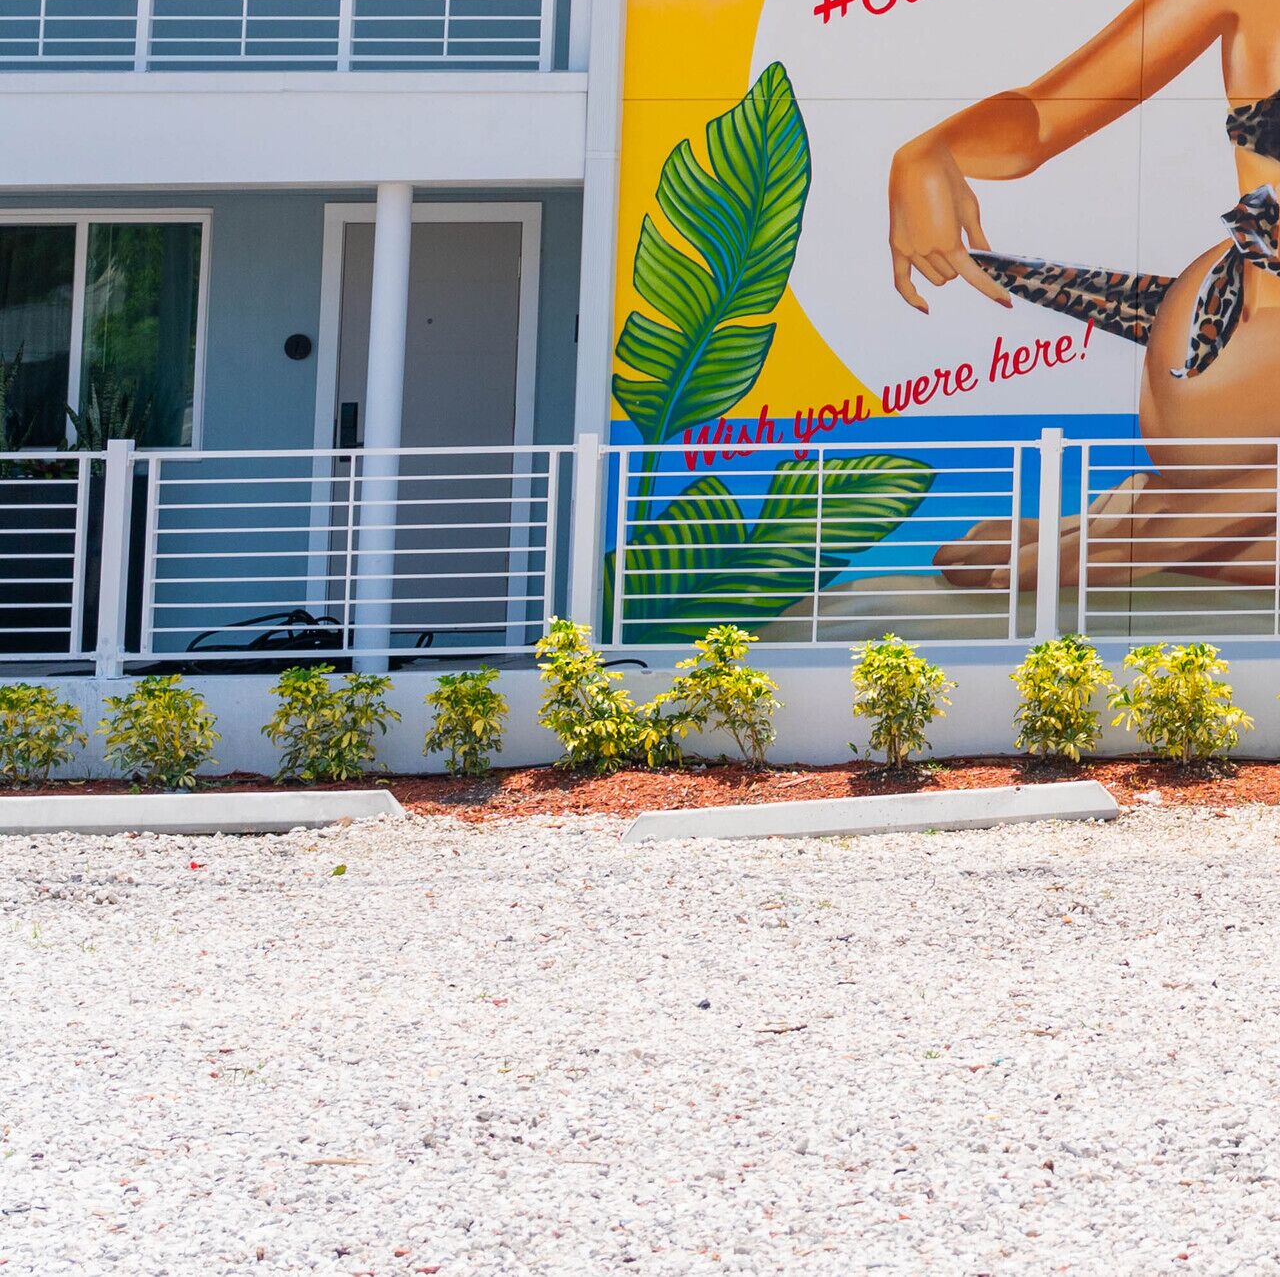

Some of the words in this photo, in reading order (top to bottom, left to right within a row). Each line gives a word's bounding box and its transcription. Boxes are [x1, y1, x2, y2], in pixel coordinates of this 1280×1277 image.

[683, 404, 783, 471] Wish
[793, 394, 872, 461] you
[882, 361, 979, 415] were
[990, 317, 1095, 384] here!
